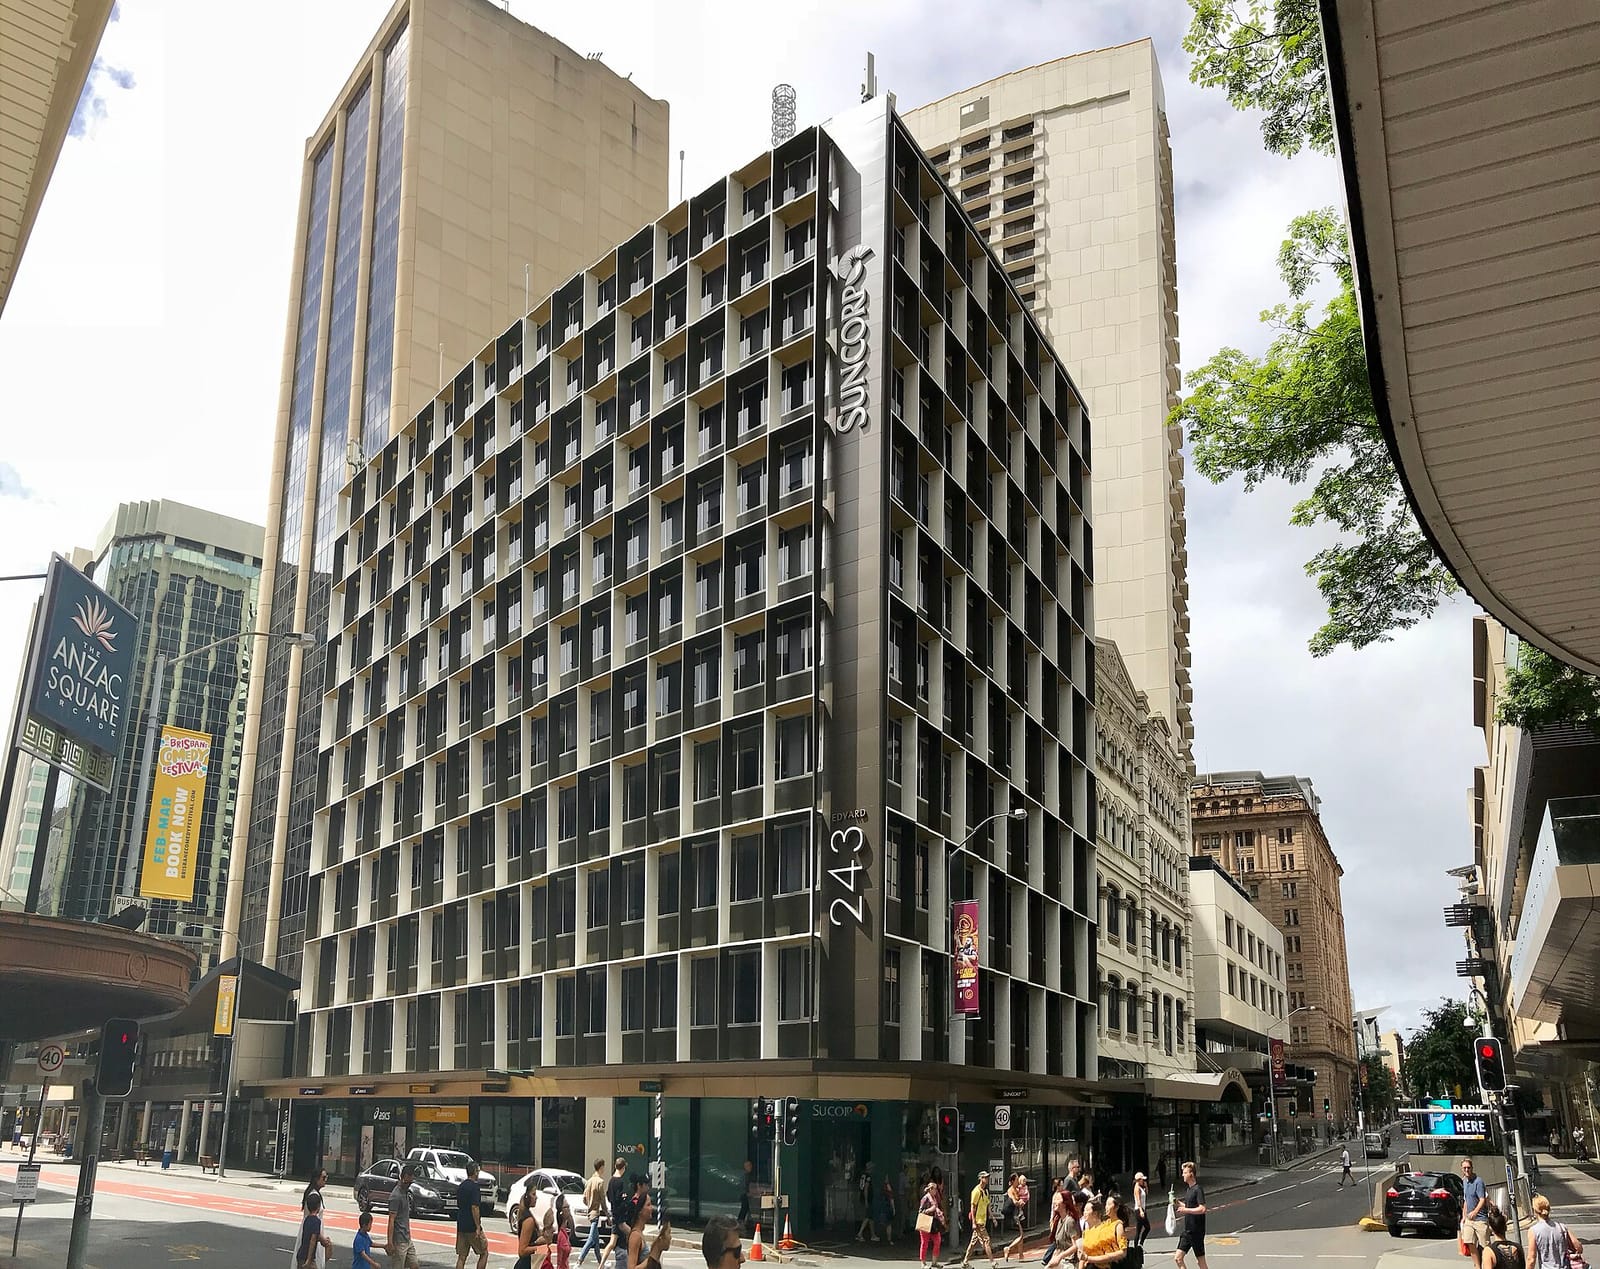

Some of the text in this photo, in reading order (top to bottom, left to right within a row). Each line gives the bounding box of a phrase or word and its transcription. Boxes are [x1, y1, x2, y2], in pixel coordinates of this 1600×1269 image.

[837, 285, 868, 434] SUNCORP
[83, 641, 101, 658] THE
[52, 636, 122, 700] ANZAC
[48, 666, 120, 728] SQUARE
[44, 690, 116, 737] ARCADE
[170, 738, 208, 750] BRISBANE
[160, 747, 210, 766] COMEDY
[165, 786, 189, 878] BOOK NOW
[827, 826, 863, 926] 243
[41, 1051, 60, 1065] 40
[997, 1111, 1008, 1121] 40
[1453, 1104, 1485, 1116] PARK
[593, 1120, 606, 1128] 243
[1456, 1120, 1486, 1132] HERE
